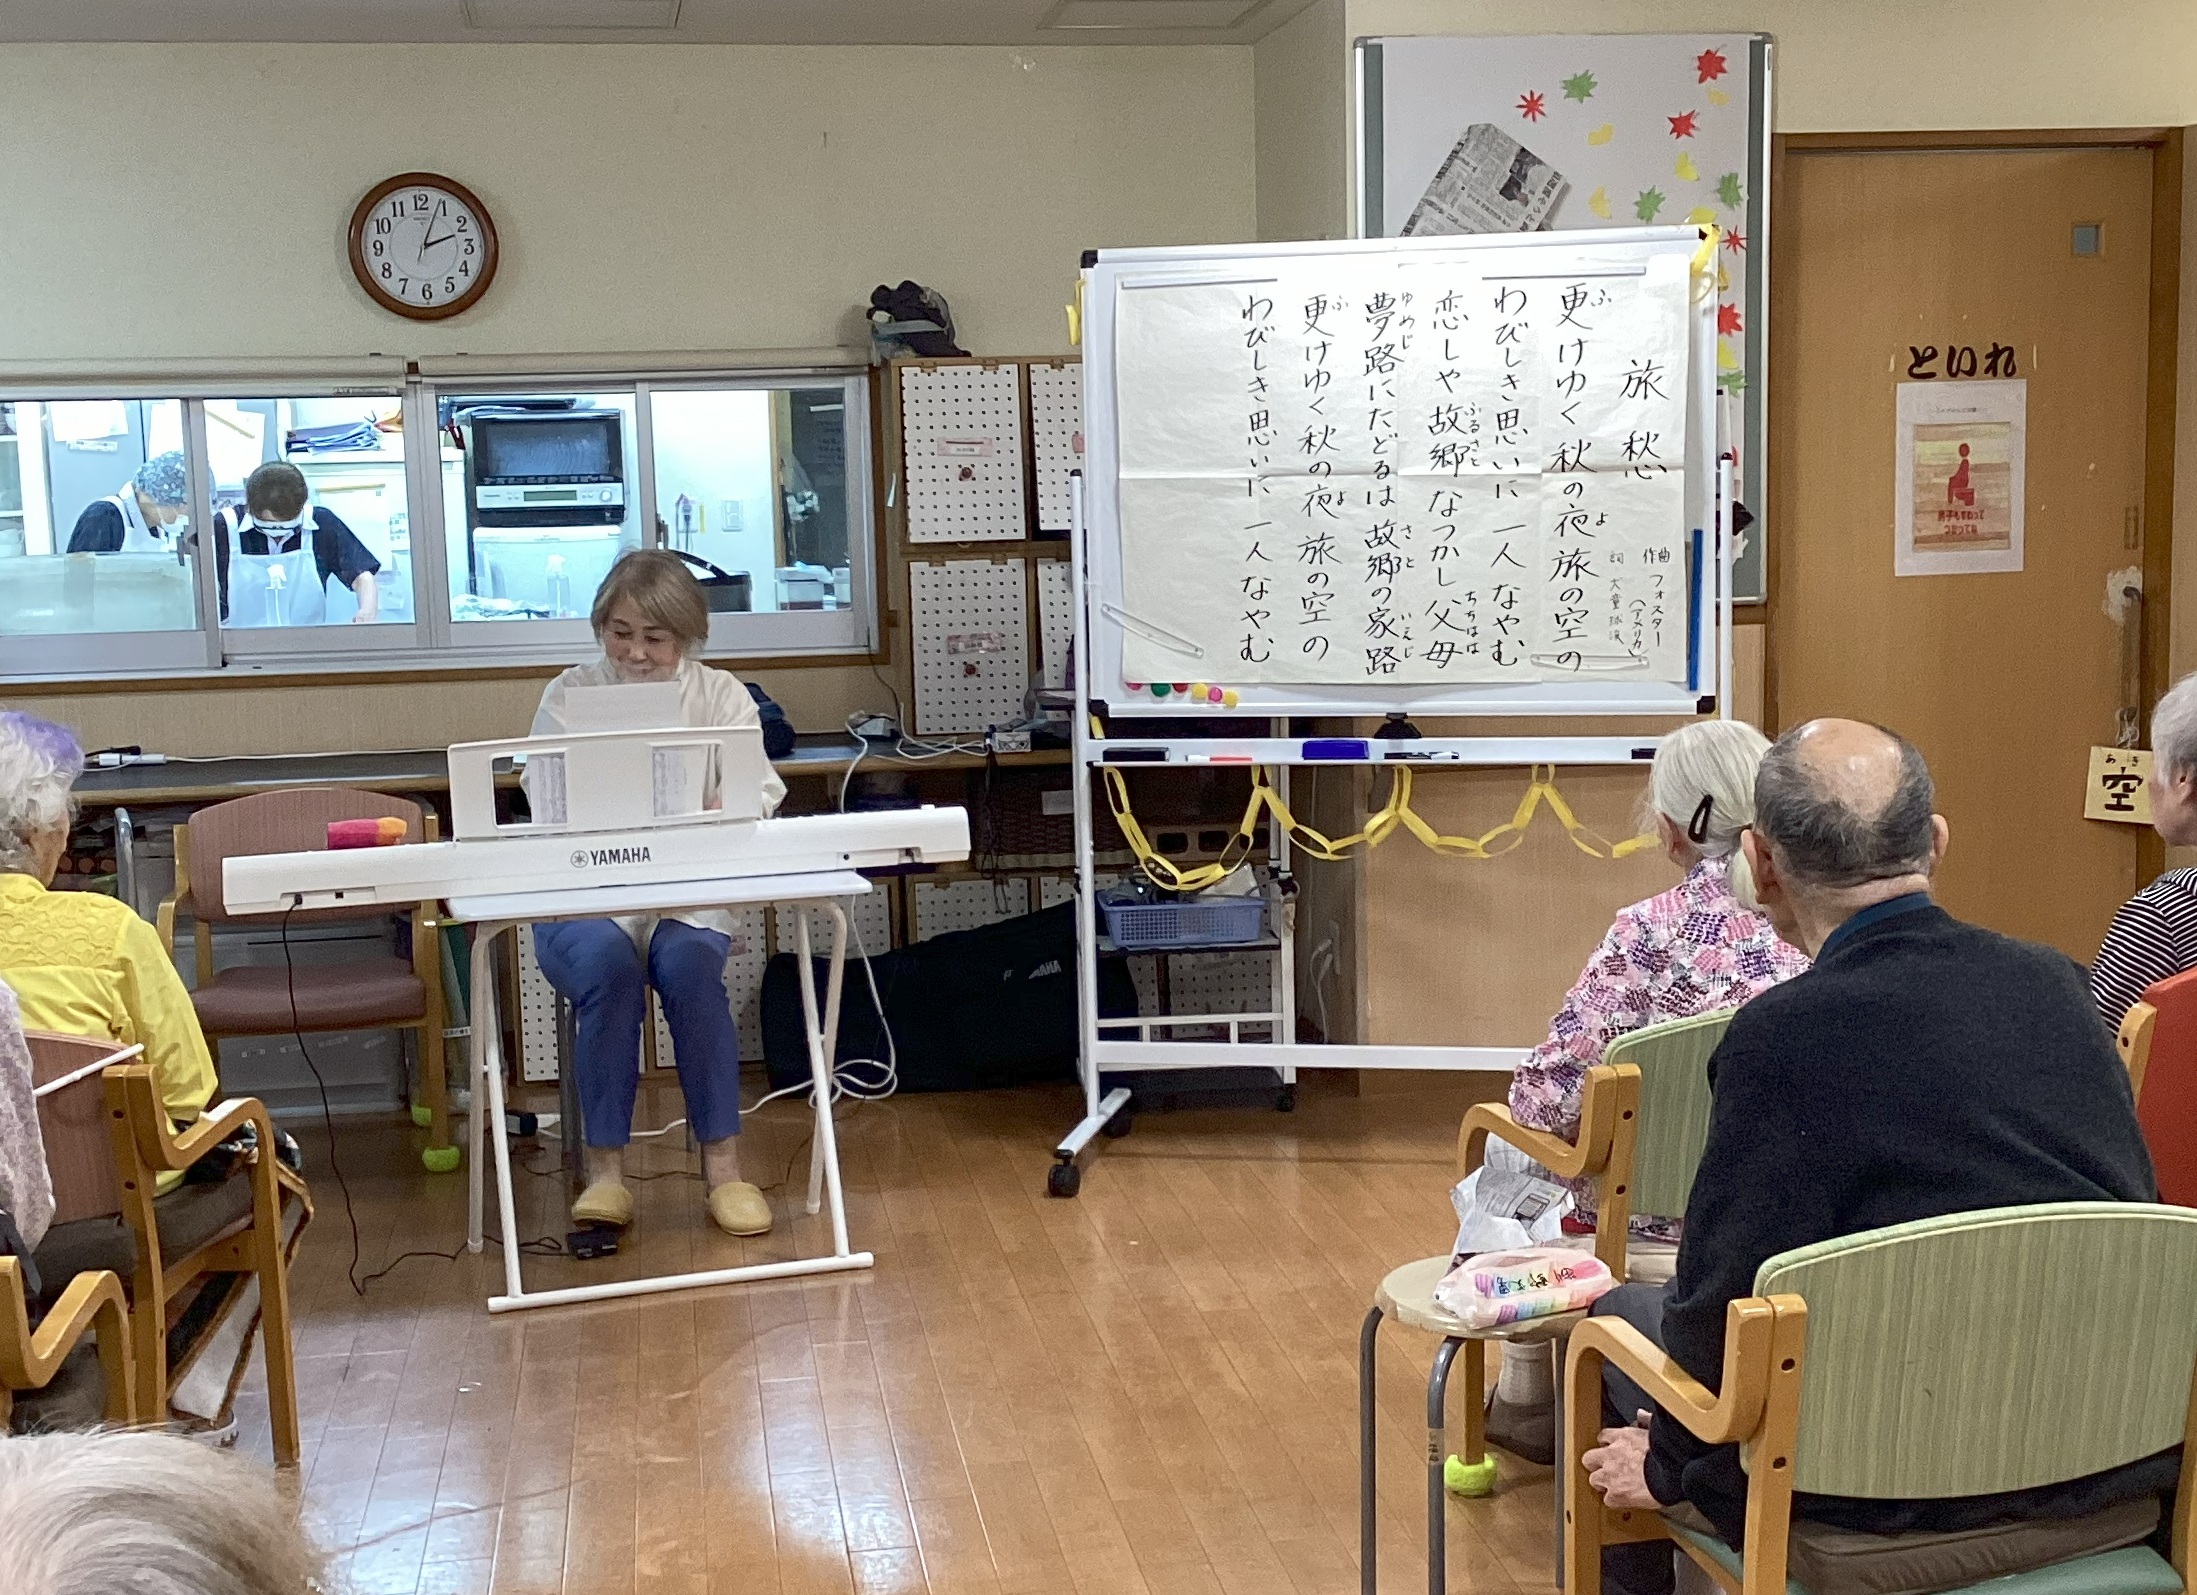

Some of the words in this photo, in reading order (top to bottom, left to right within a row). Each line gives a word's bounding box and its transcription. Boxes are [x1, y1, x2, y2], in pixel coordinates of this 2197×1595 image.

[391, 201, 405, 218] 11
[413, 193, 429, 211] 12
[441, 200, 448, 217] 1
[375, 217, 392, 235] 10
[456, 216, 468, 233] 2
[372, 240, 384, 257] 9
[463, 238, 475, 255] 3
[381, 262, 393, 279] 8
[458, 260, 470, 277] 4
[398, 278, 409, 295] 7
[421, 283, 433, 300] 6
[444, 276, 456, 293] 5
[1907, 342, 2017, 379] といれ
[1336, 491, 1347, 506] よ
[1595, 512, 1609, 527] よ
[2102, 766, 2144, 812] 空
[590, 846, 651, 866] YAMAHA
